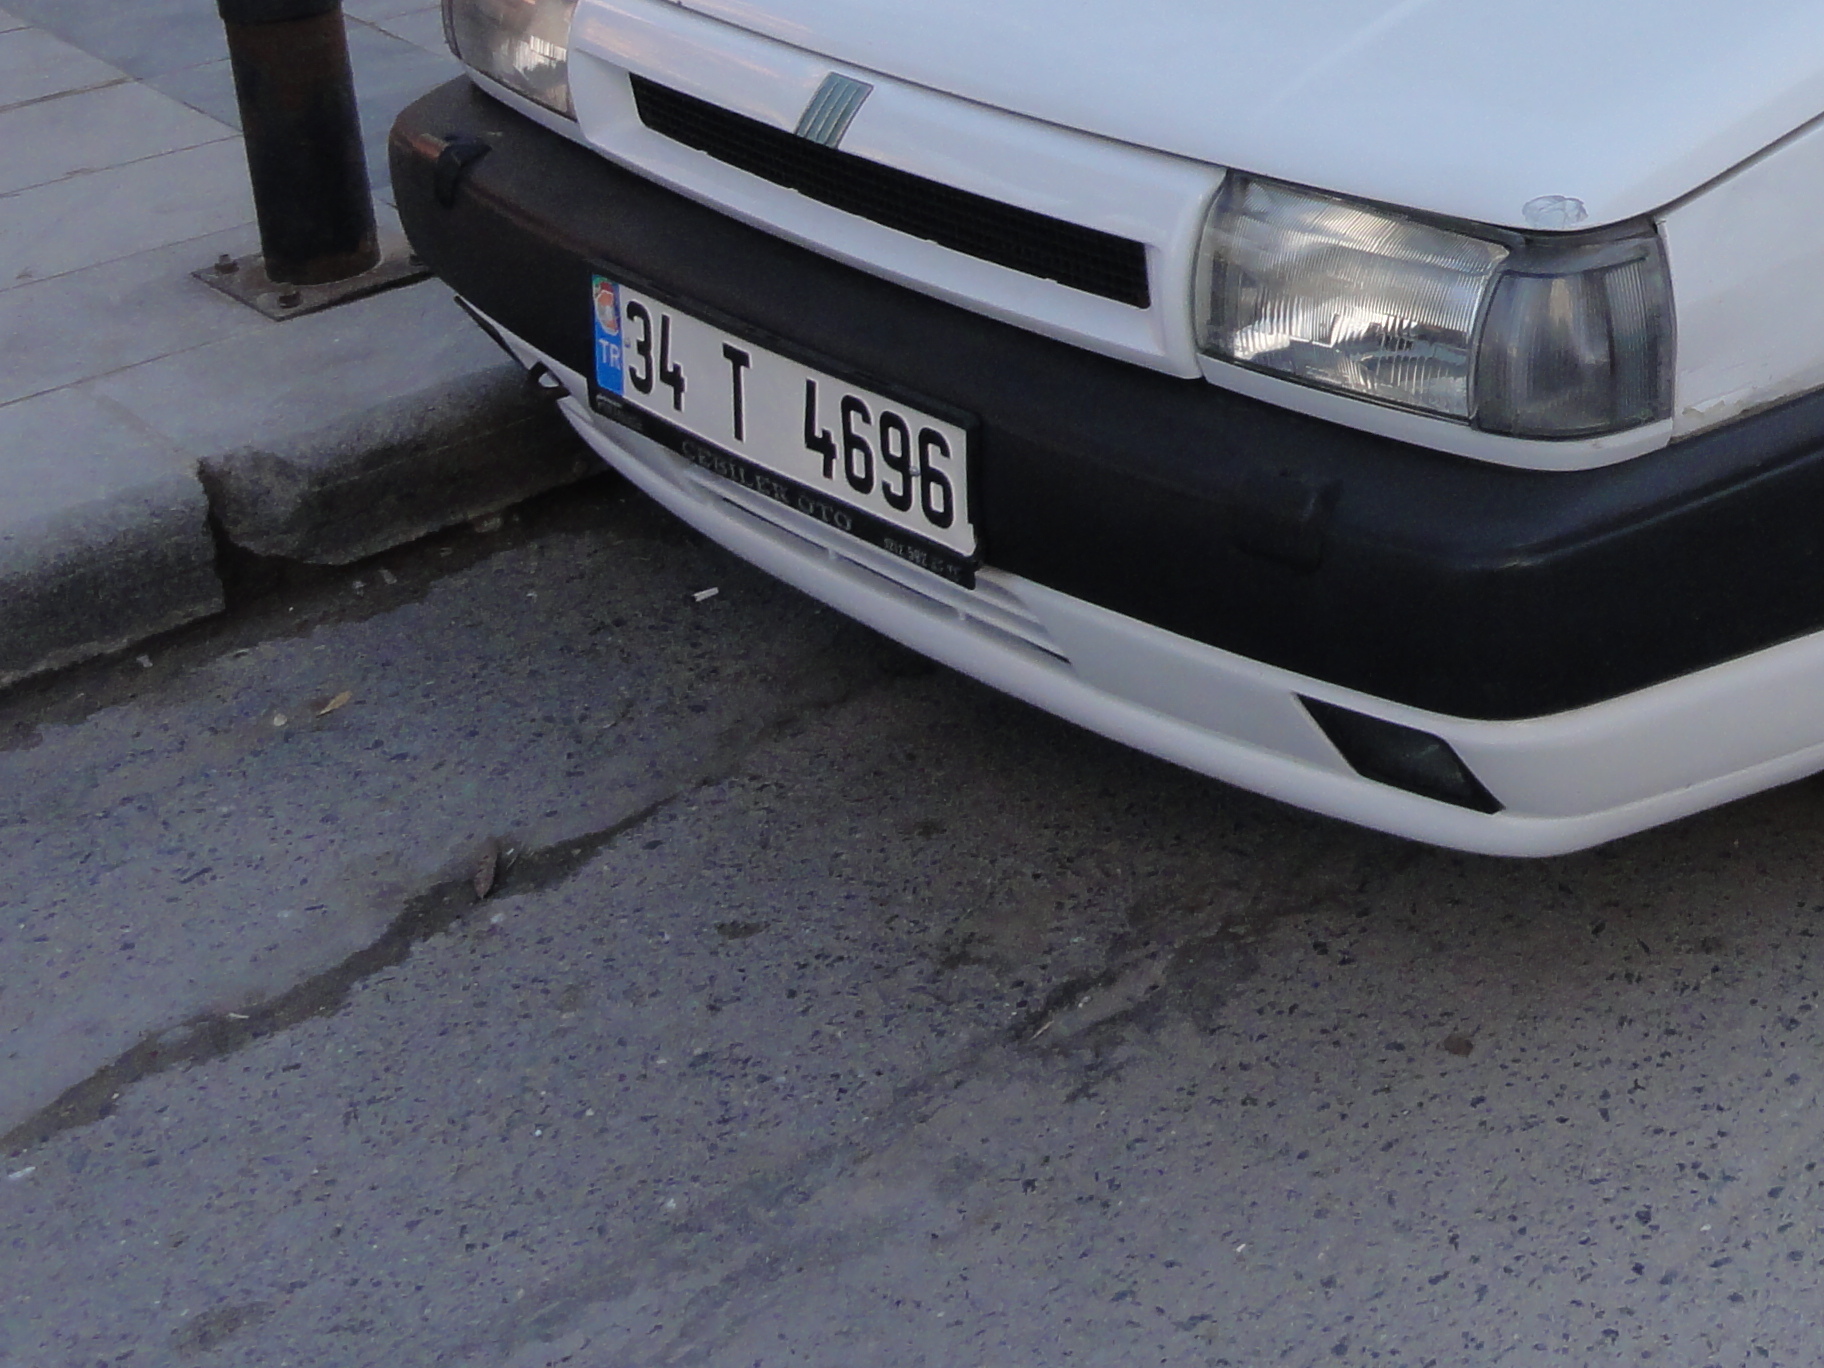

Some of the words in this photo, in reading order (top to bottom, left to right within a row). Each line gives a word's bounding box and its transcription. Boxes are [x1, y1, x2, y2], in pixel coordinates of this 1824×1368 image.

[599, 338, 621, 371] TR
[626, 300, 687, 413] 34
[722, 342, 752, 443] T
[804, 378, 954, 530] 4696
